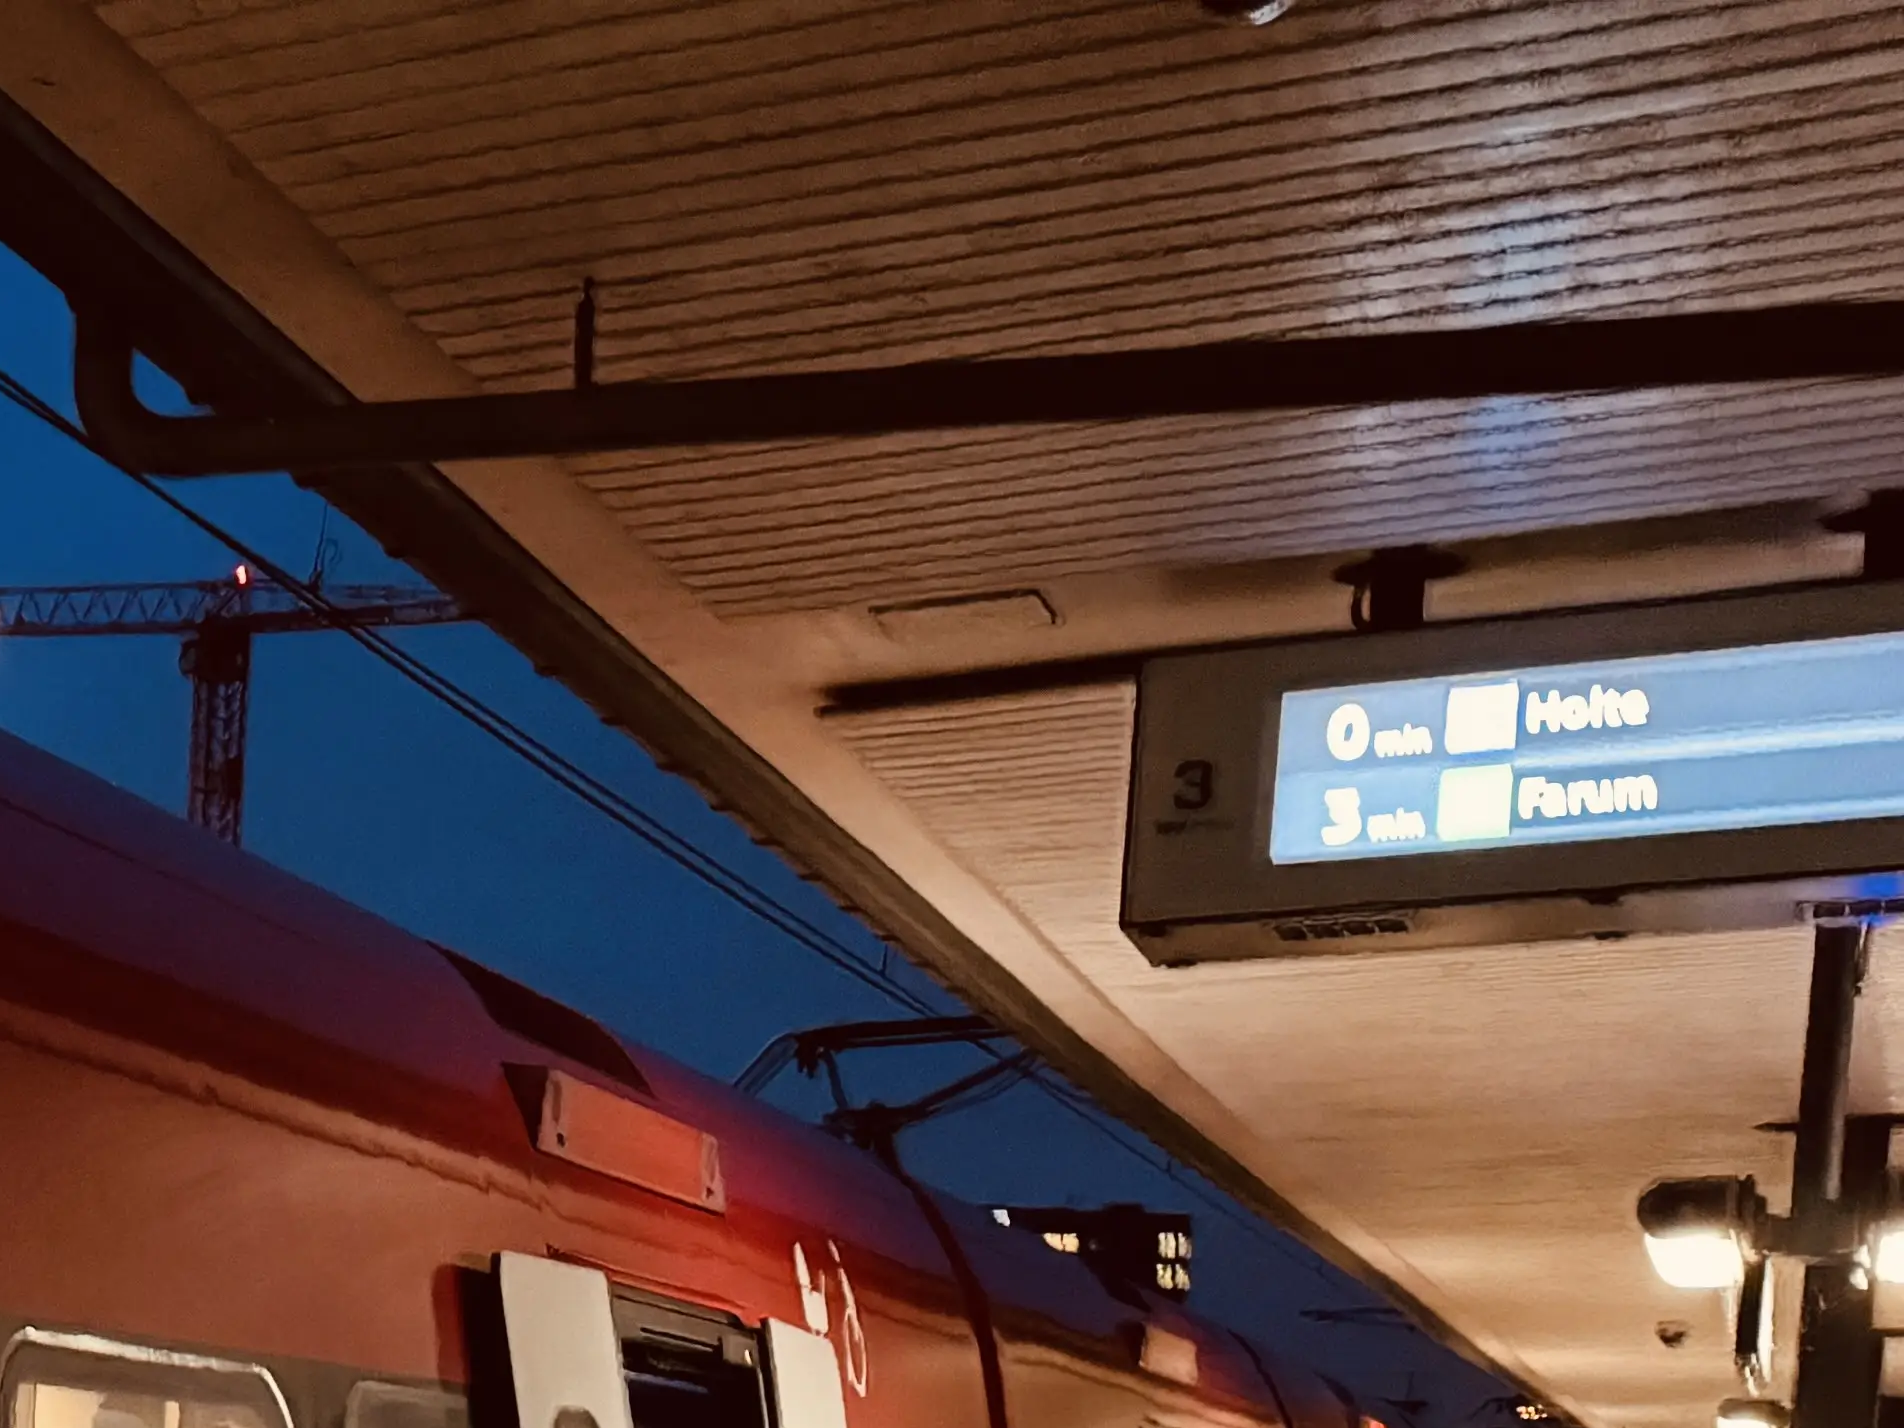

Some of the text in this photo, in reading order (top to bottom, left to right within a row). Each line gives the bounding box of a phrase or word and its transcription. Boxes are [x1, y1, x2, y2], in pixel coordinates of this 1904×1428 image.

[1326, 683, 1650, 762] 0 min Holte
[1173, 759, 1213, 810] 3
[1320, 773, 1659, 847] 3 min Farum
